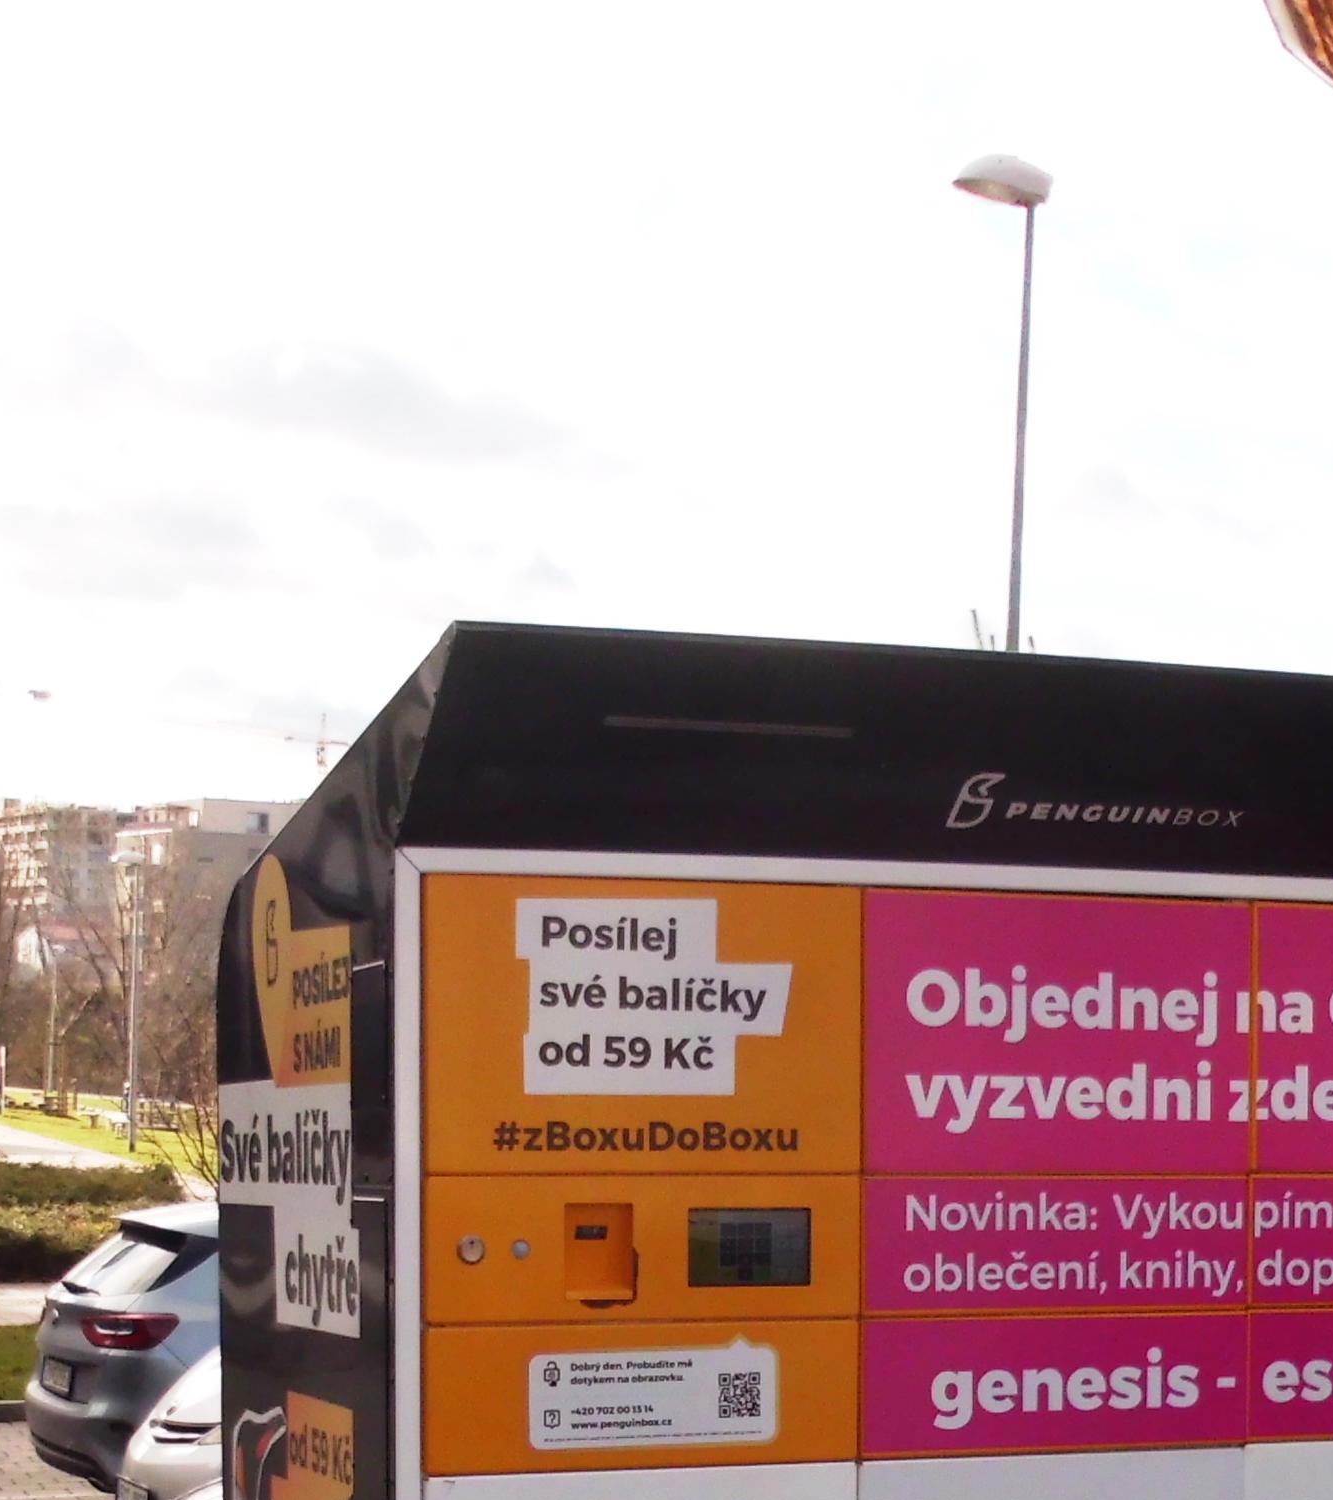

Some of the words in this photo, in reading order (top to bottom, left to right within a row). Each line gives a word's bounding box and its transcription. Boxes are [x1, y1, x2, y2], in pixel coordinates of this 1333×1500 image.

[1004, 802, 1244, 828] PENGUINBOX
[540, 915, 678, 961] Posílej
[539, 974, 607, 1009] své
[618, 977, 767, 1021] balíčky
[904, 965, 1219, 1046] Objednej
[1236, 988, 1313, 1035] na
[538, 1034, 591, 1067] od
[602, 1036, 652, 1068] 59
[663, 1036, 715, 1070] Kč
[904, 1060, 1214, 1134] vyzvedni
[220, 1111, 262, 1184] Své
[266, 1108, 351, 1206] balíčky
[493, 1120, 799, 1152] #zBoxuDoBoxu
[903, 1194, 1099, 1232] Novinka:
[285, 1233, 359, 1327] chytře
[902, 1250, 1108, 1295] oblečení,
[1119, 1252, 1245, 1298] knihy,
[570, 1361, 601, 1373] Dobrý
[570, 1375, 615, 1387] dotykem
[617, 1375, 630, 1384] na
[930, 1346, 1200, 1430] genesis
[596, 1405, 615, 1415] 702
[616, 1405, 631, 1414] 00
